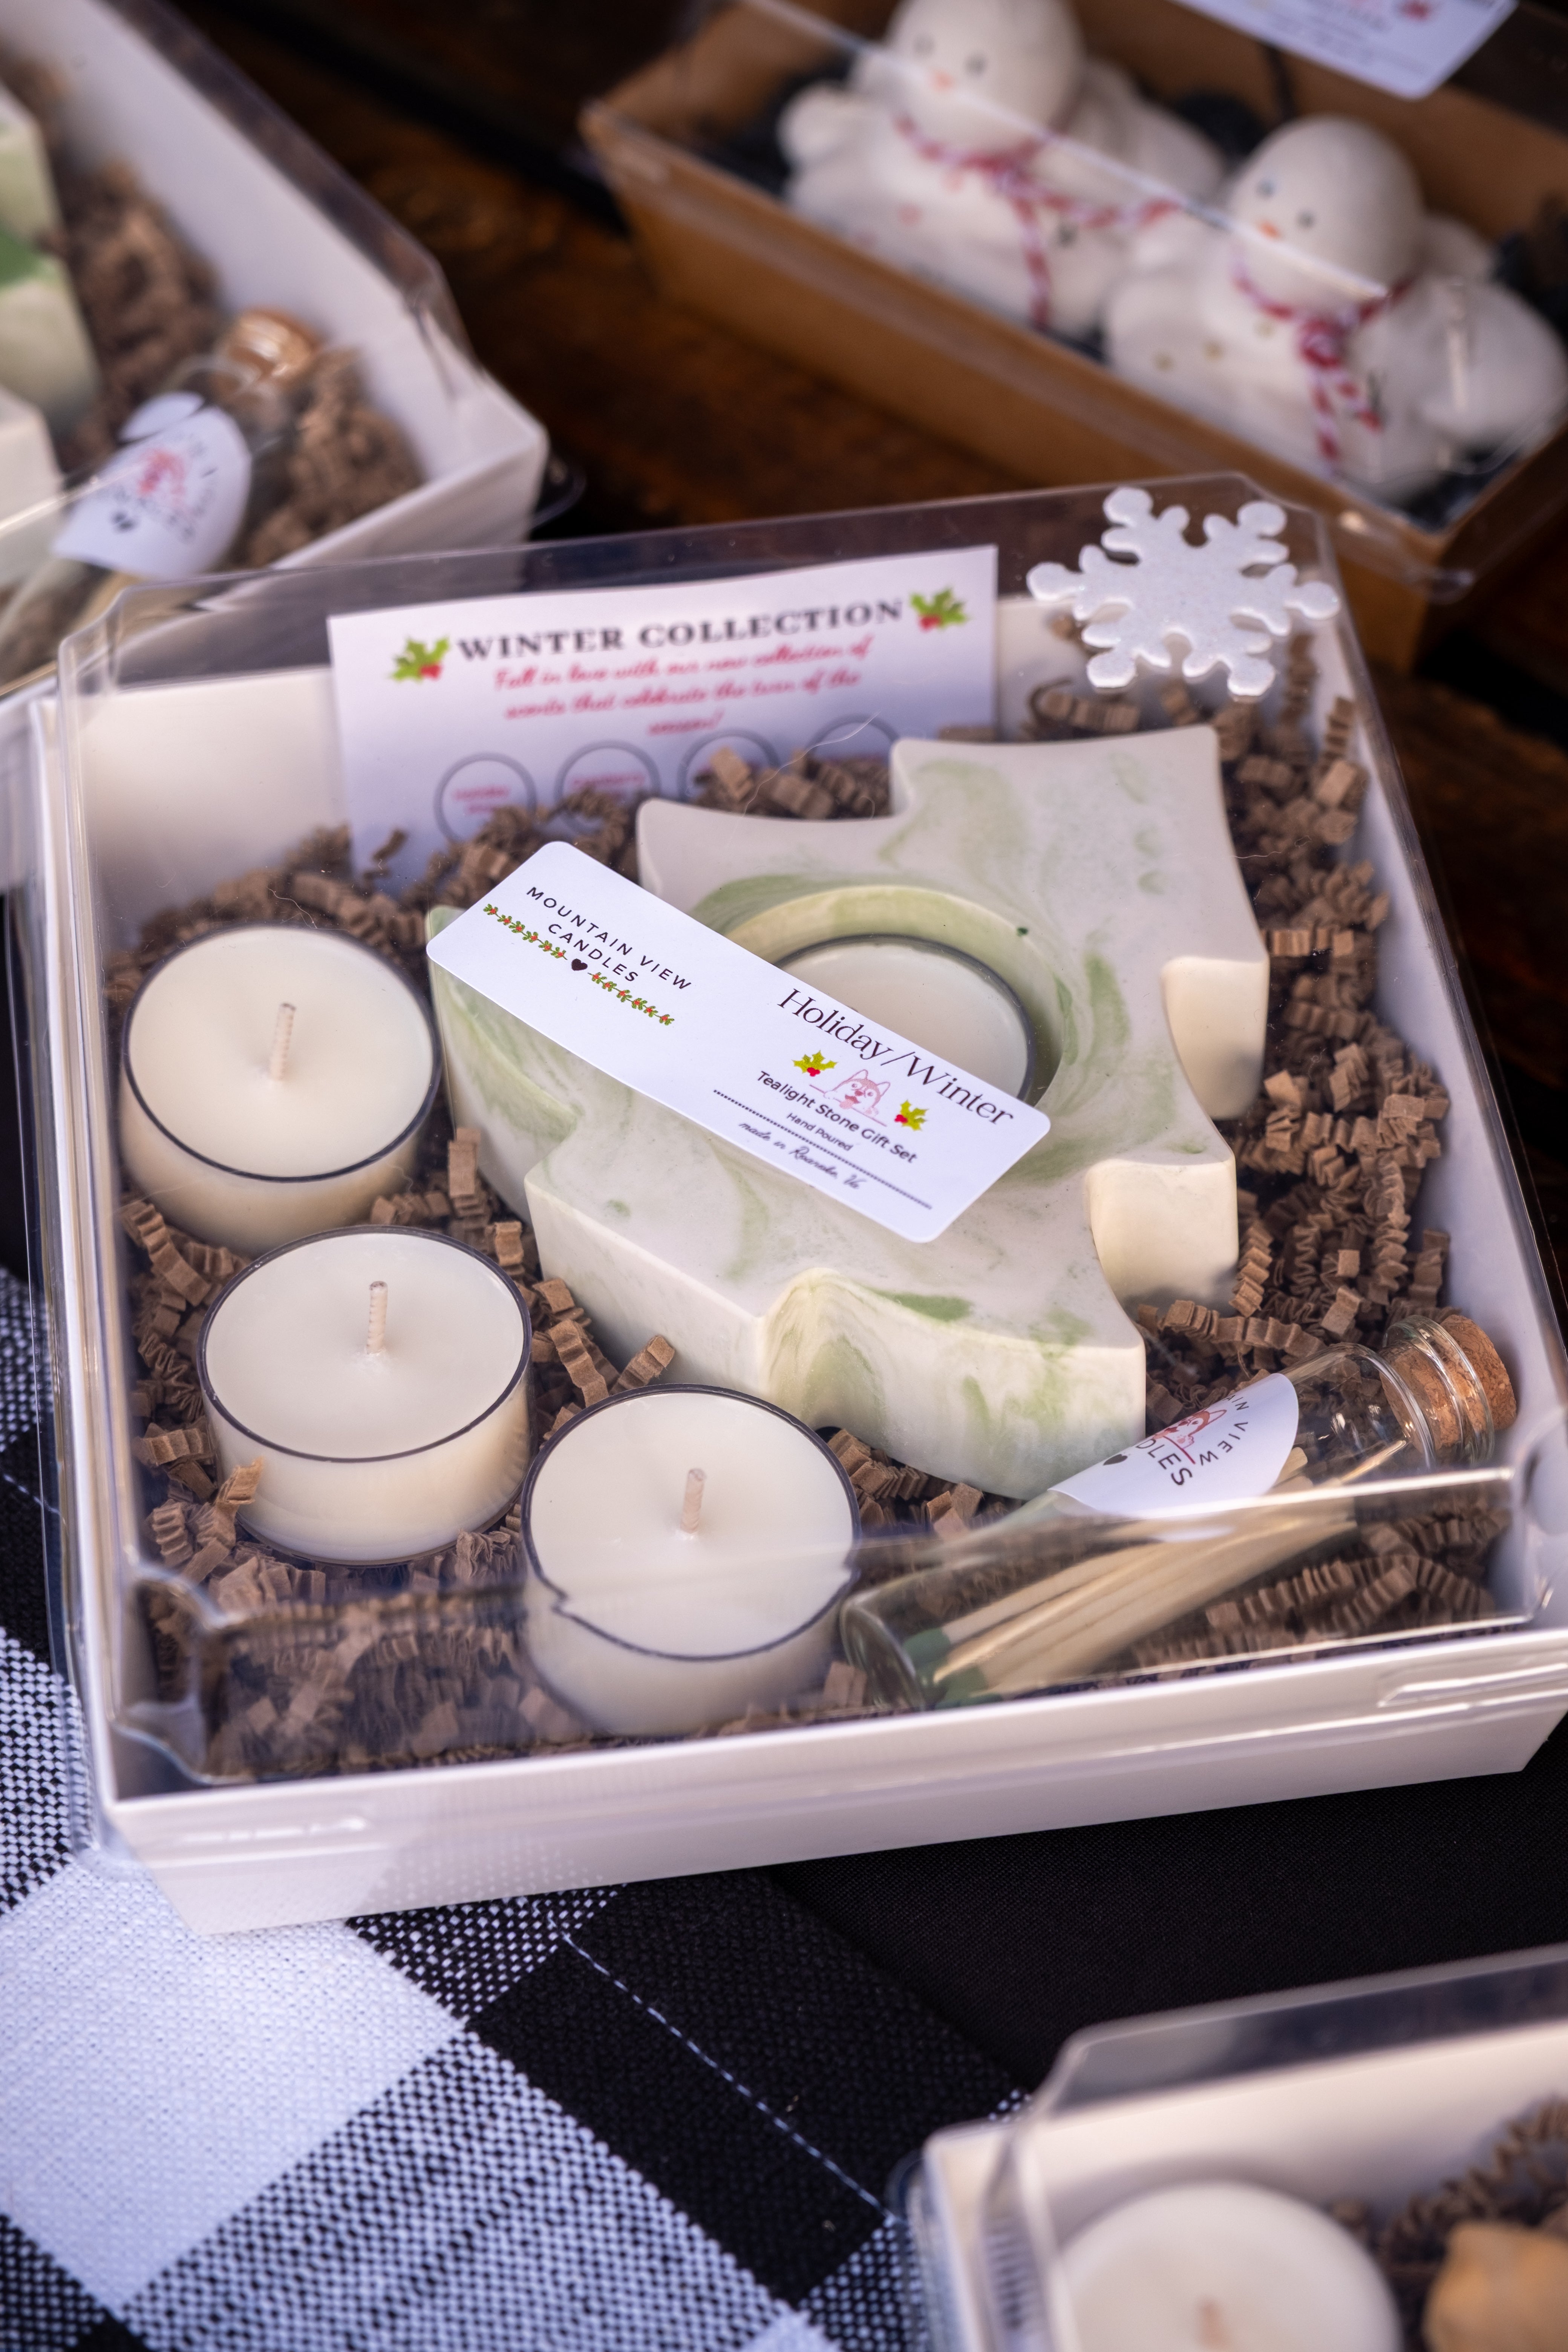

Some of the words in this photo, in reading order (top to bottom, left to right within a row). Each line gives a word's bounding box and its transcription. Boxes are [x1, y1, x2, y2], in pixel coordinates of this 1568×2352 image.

[458, 626, 623, 661] WINTER
[638, 600, 903, 649] COLLECTION
[527, 887, 632, 956] MOUNTAIN
[640, 955, 692, 989] VIEW
[548, 923, 639, 982] CANDLES
[777, 988, 1014, 1125] Holiday/Winter
[739, 1122, 771, 1141] made
[773, 1139, 786, 1150] in
[757, 1070, 816, 1109] Tealight
[815, 1104, 859, 1132] Stone
[861, 1128, 891, 1149] Gift
[890, 1144, 918, 1164] Set
[786, 1112, 817, 1132] Hand
[815, 1127, 854, 1152] Poured
[1199, 1421, 1249, 1467] VIEW
